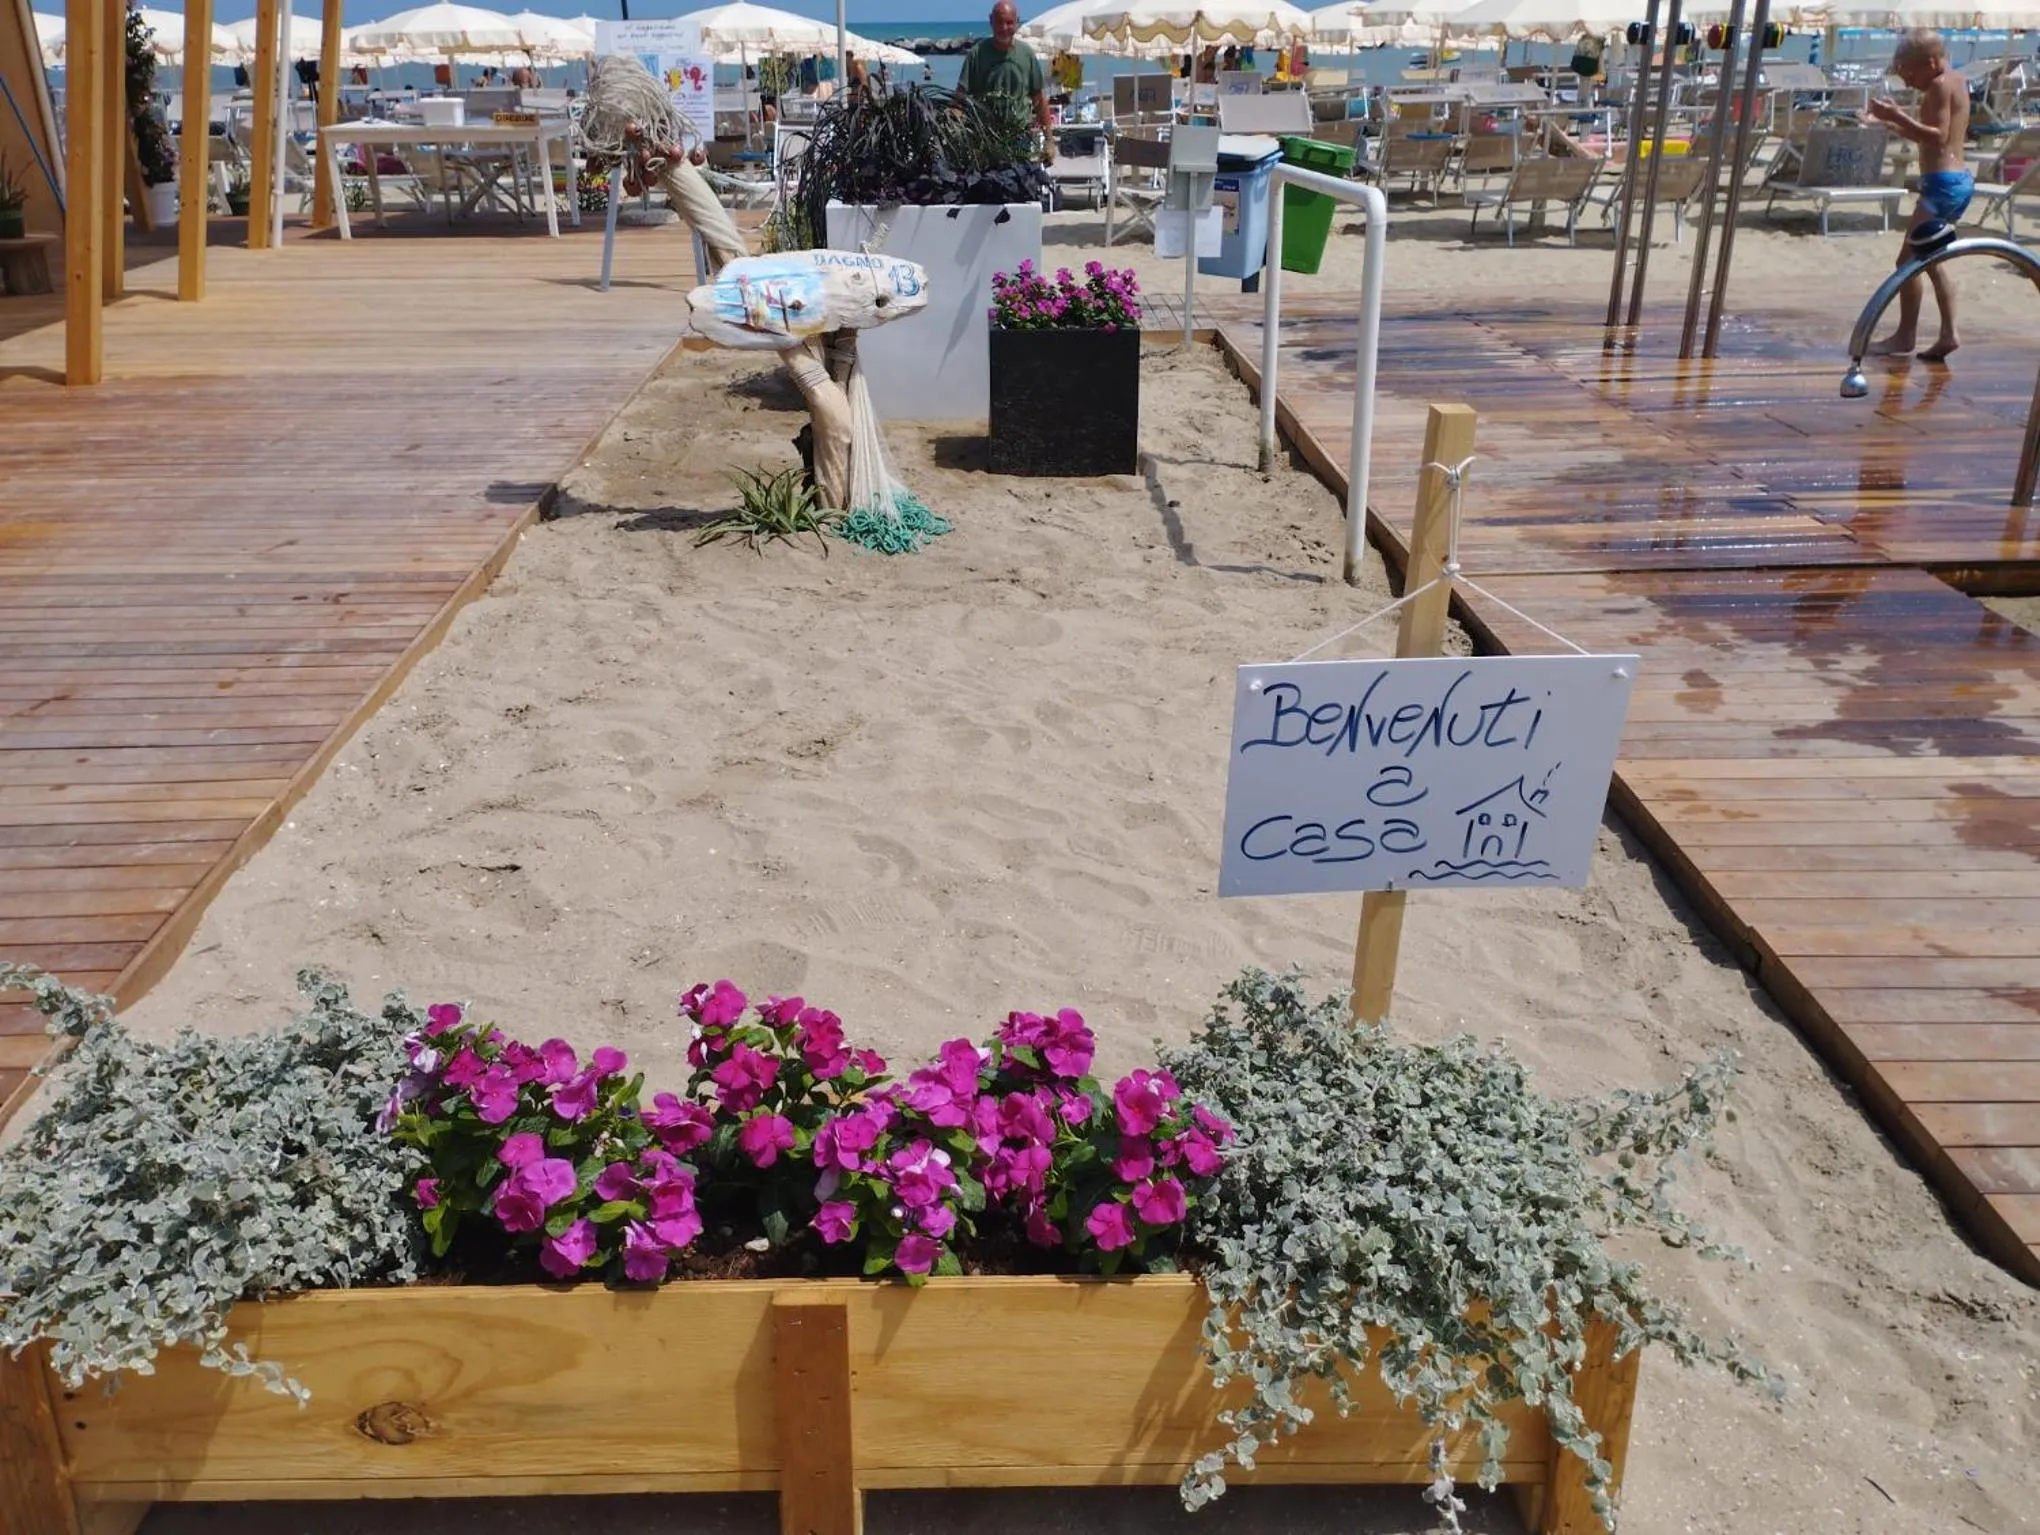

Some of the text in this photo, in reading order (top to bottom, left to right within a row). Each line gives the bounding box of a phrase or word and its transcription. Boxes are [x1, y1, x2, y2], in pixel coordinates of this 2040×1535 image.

[814, 254, 884, 269] BAGNO
[888, 264, 920, 297] 13
[1366, 765, 1429, 807] a
